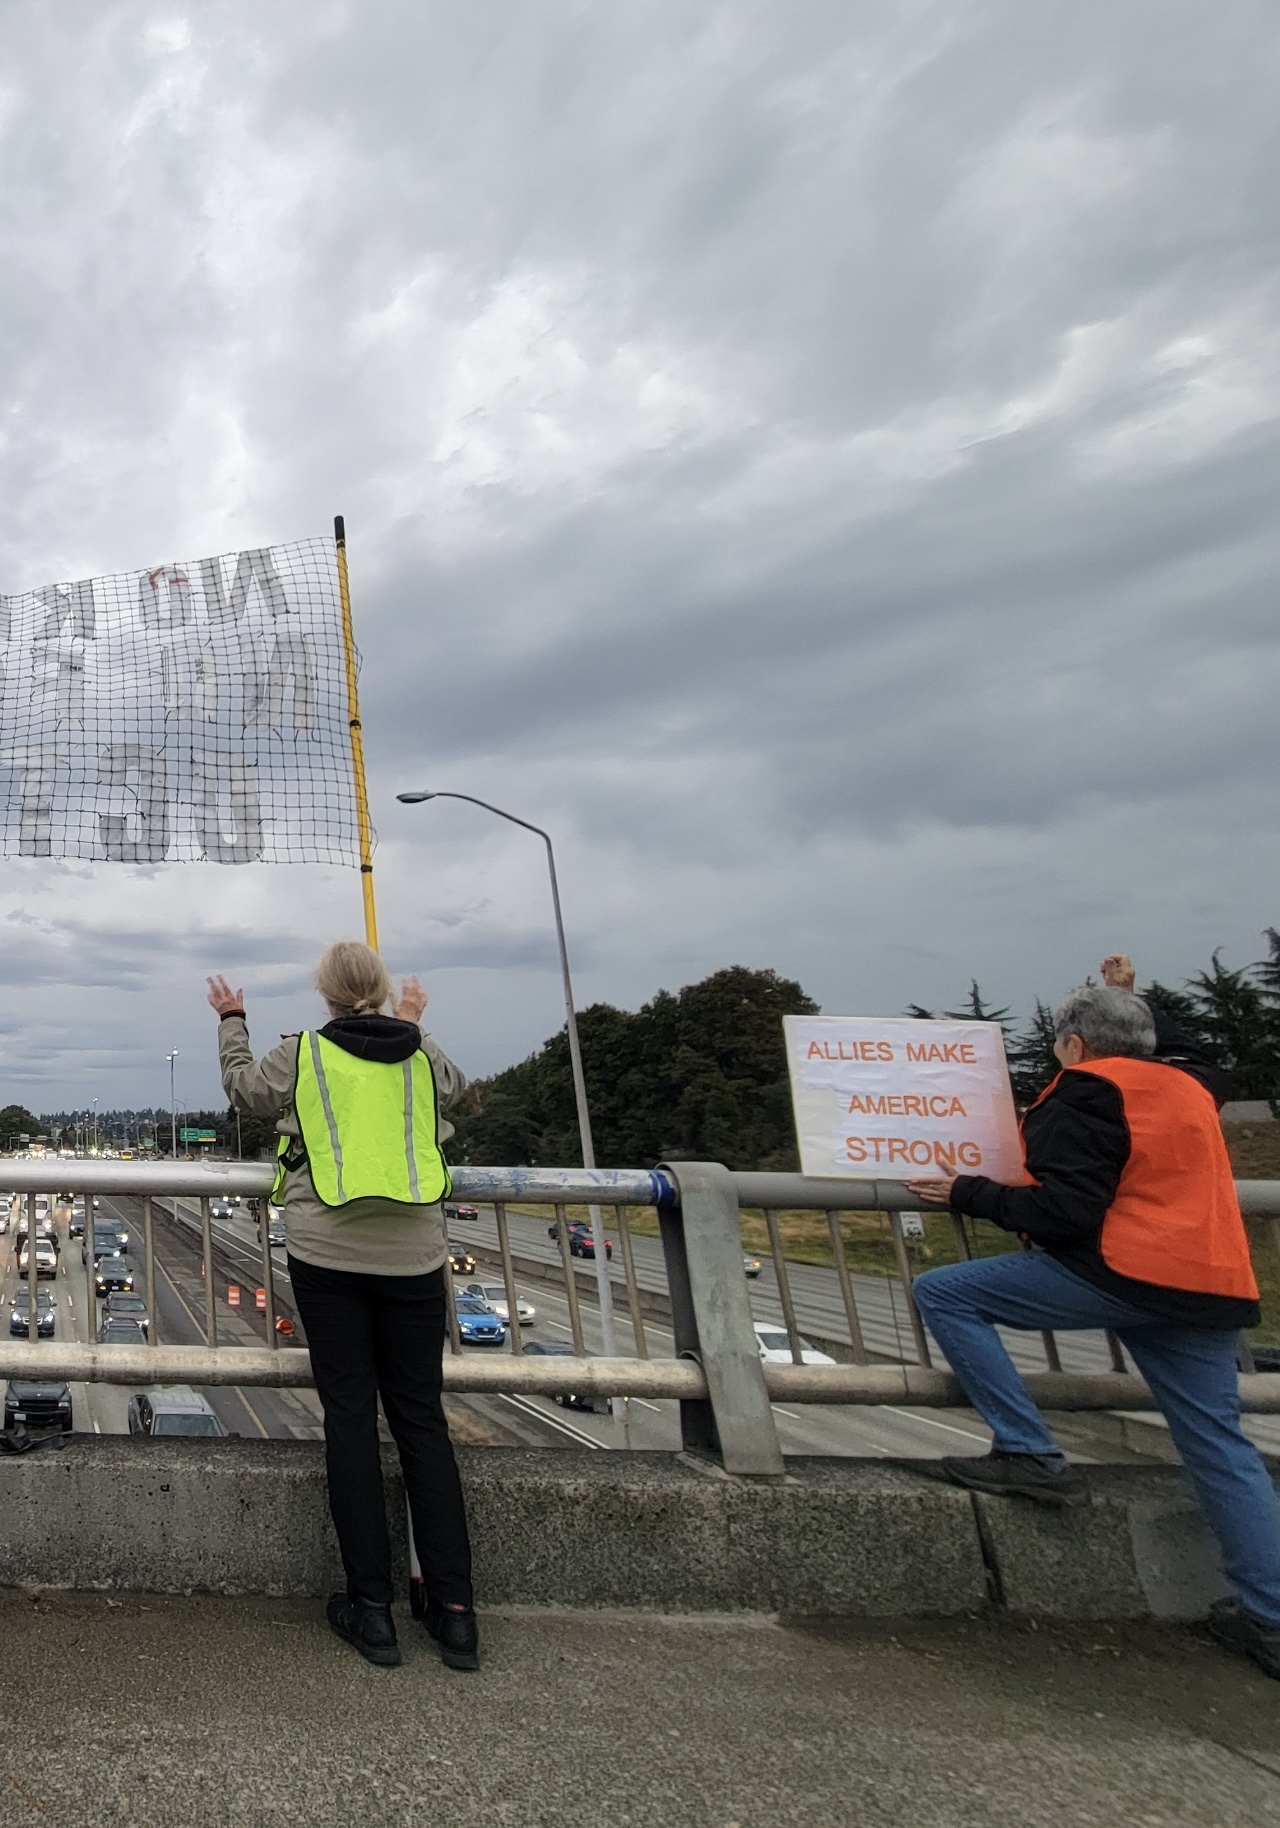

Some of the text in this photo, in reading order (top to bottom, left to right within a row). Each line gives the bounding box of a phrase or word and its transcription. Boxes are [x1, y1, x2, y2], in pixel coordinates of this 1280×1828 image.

[807, 1041, 977, 1064] ALLIES MAKE
[848, 1095, 968, 1118] AMERICA
[846, 1137, 982, 1167] STRONG
